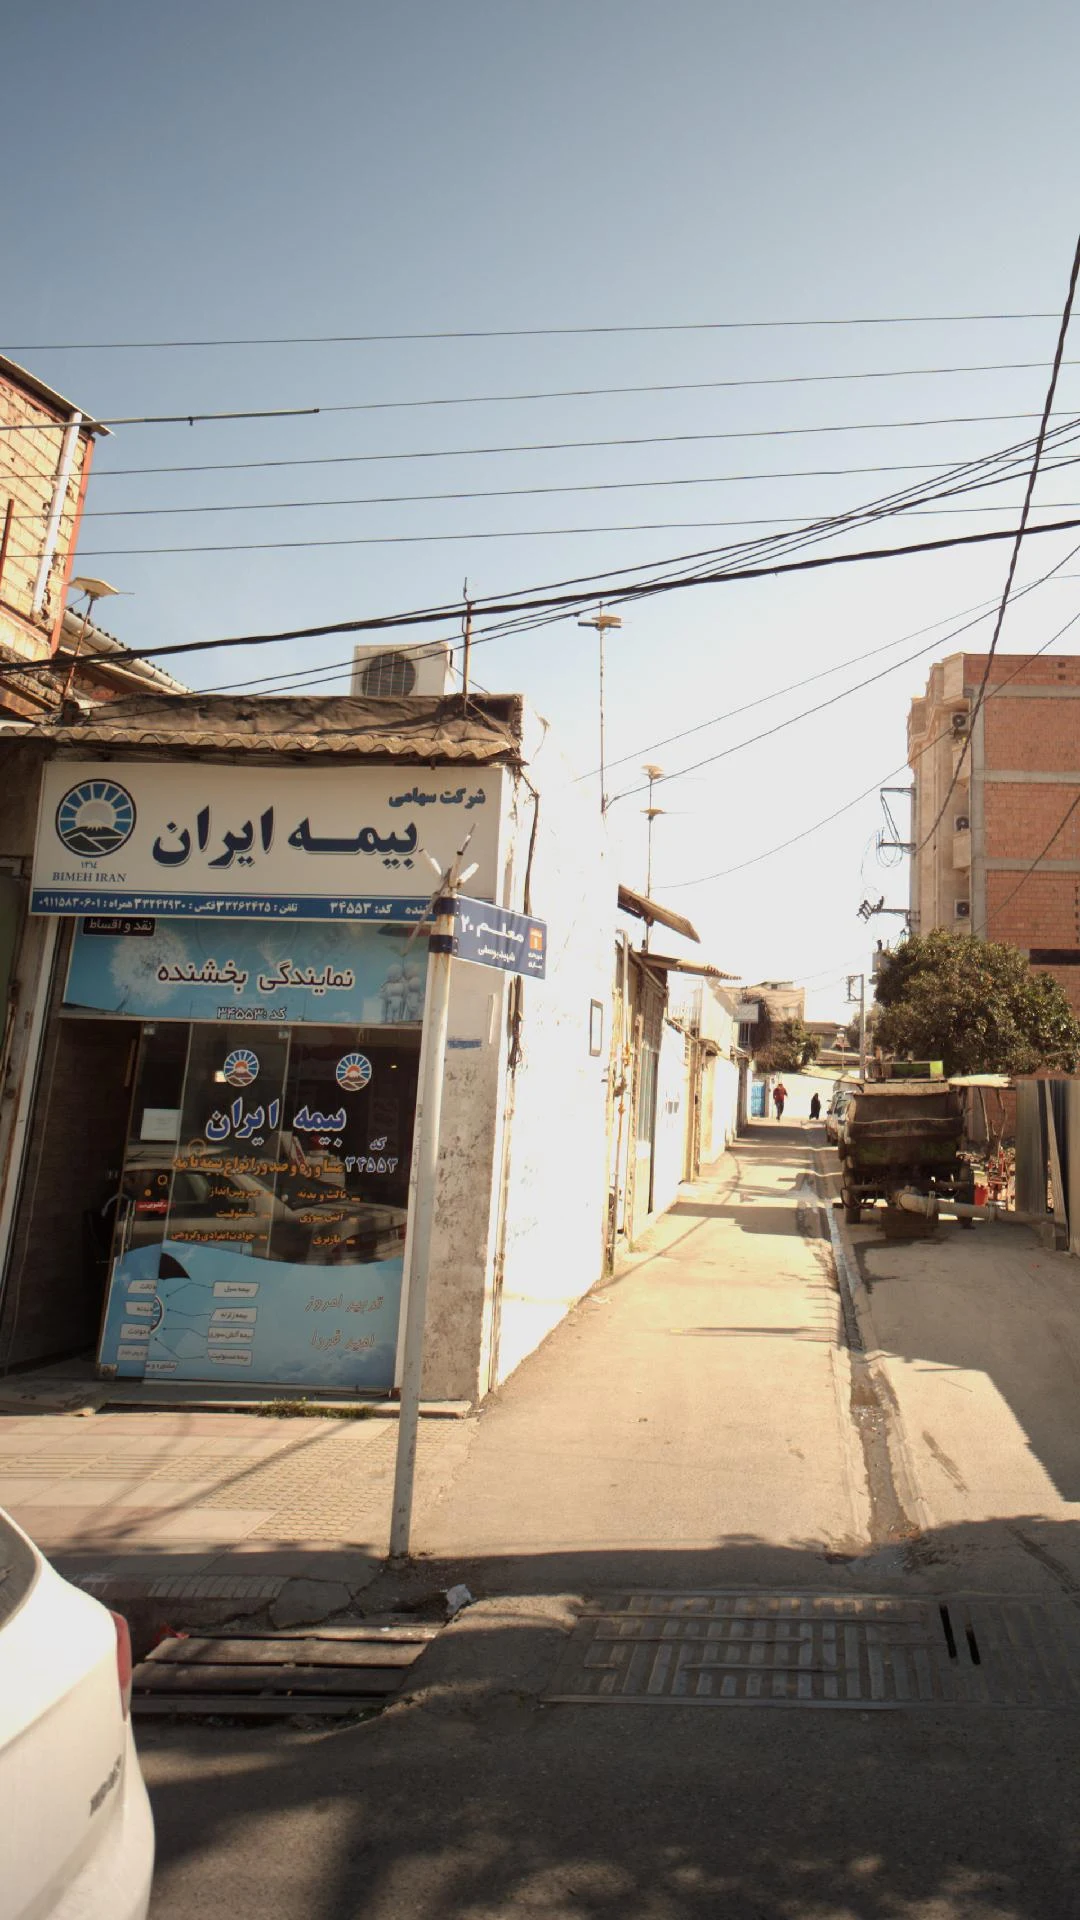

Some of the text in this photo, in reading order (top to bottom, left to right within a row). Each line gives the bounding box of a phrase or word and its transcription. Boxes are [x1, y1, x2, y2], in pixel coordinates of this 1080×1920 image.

[389, 787, 486, 808] شرکت سهامی
[152, 804, 419, 869] بیمه ایران
[52, 872, 127, 883] BIMEH IRAN
[329, 901, 372, 914] ۳۴۵۵۳
[89, 918, 153, 933] نقد و اقساط
[476, 922, 524, 943] معلم
[157, 959, 355, 995] نمایندگی بخشنده
[270, 1006, 287, 1020] کد
[205, 1097, 347, 1148] بیمه ایران
[369, 1137, 388, 1151] کد
[223, 1155, 256, 1177] انواع
[299, 1154, 346, 1178] مشاوره
